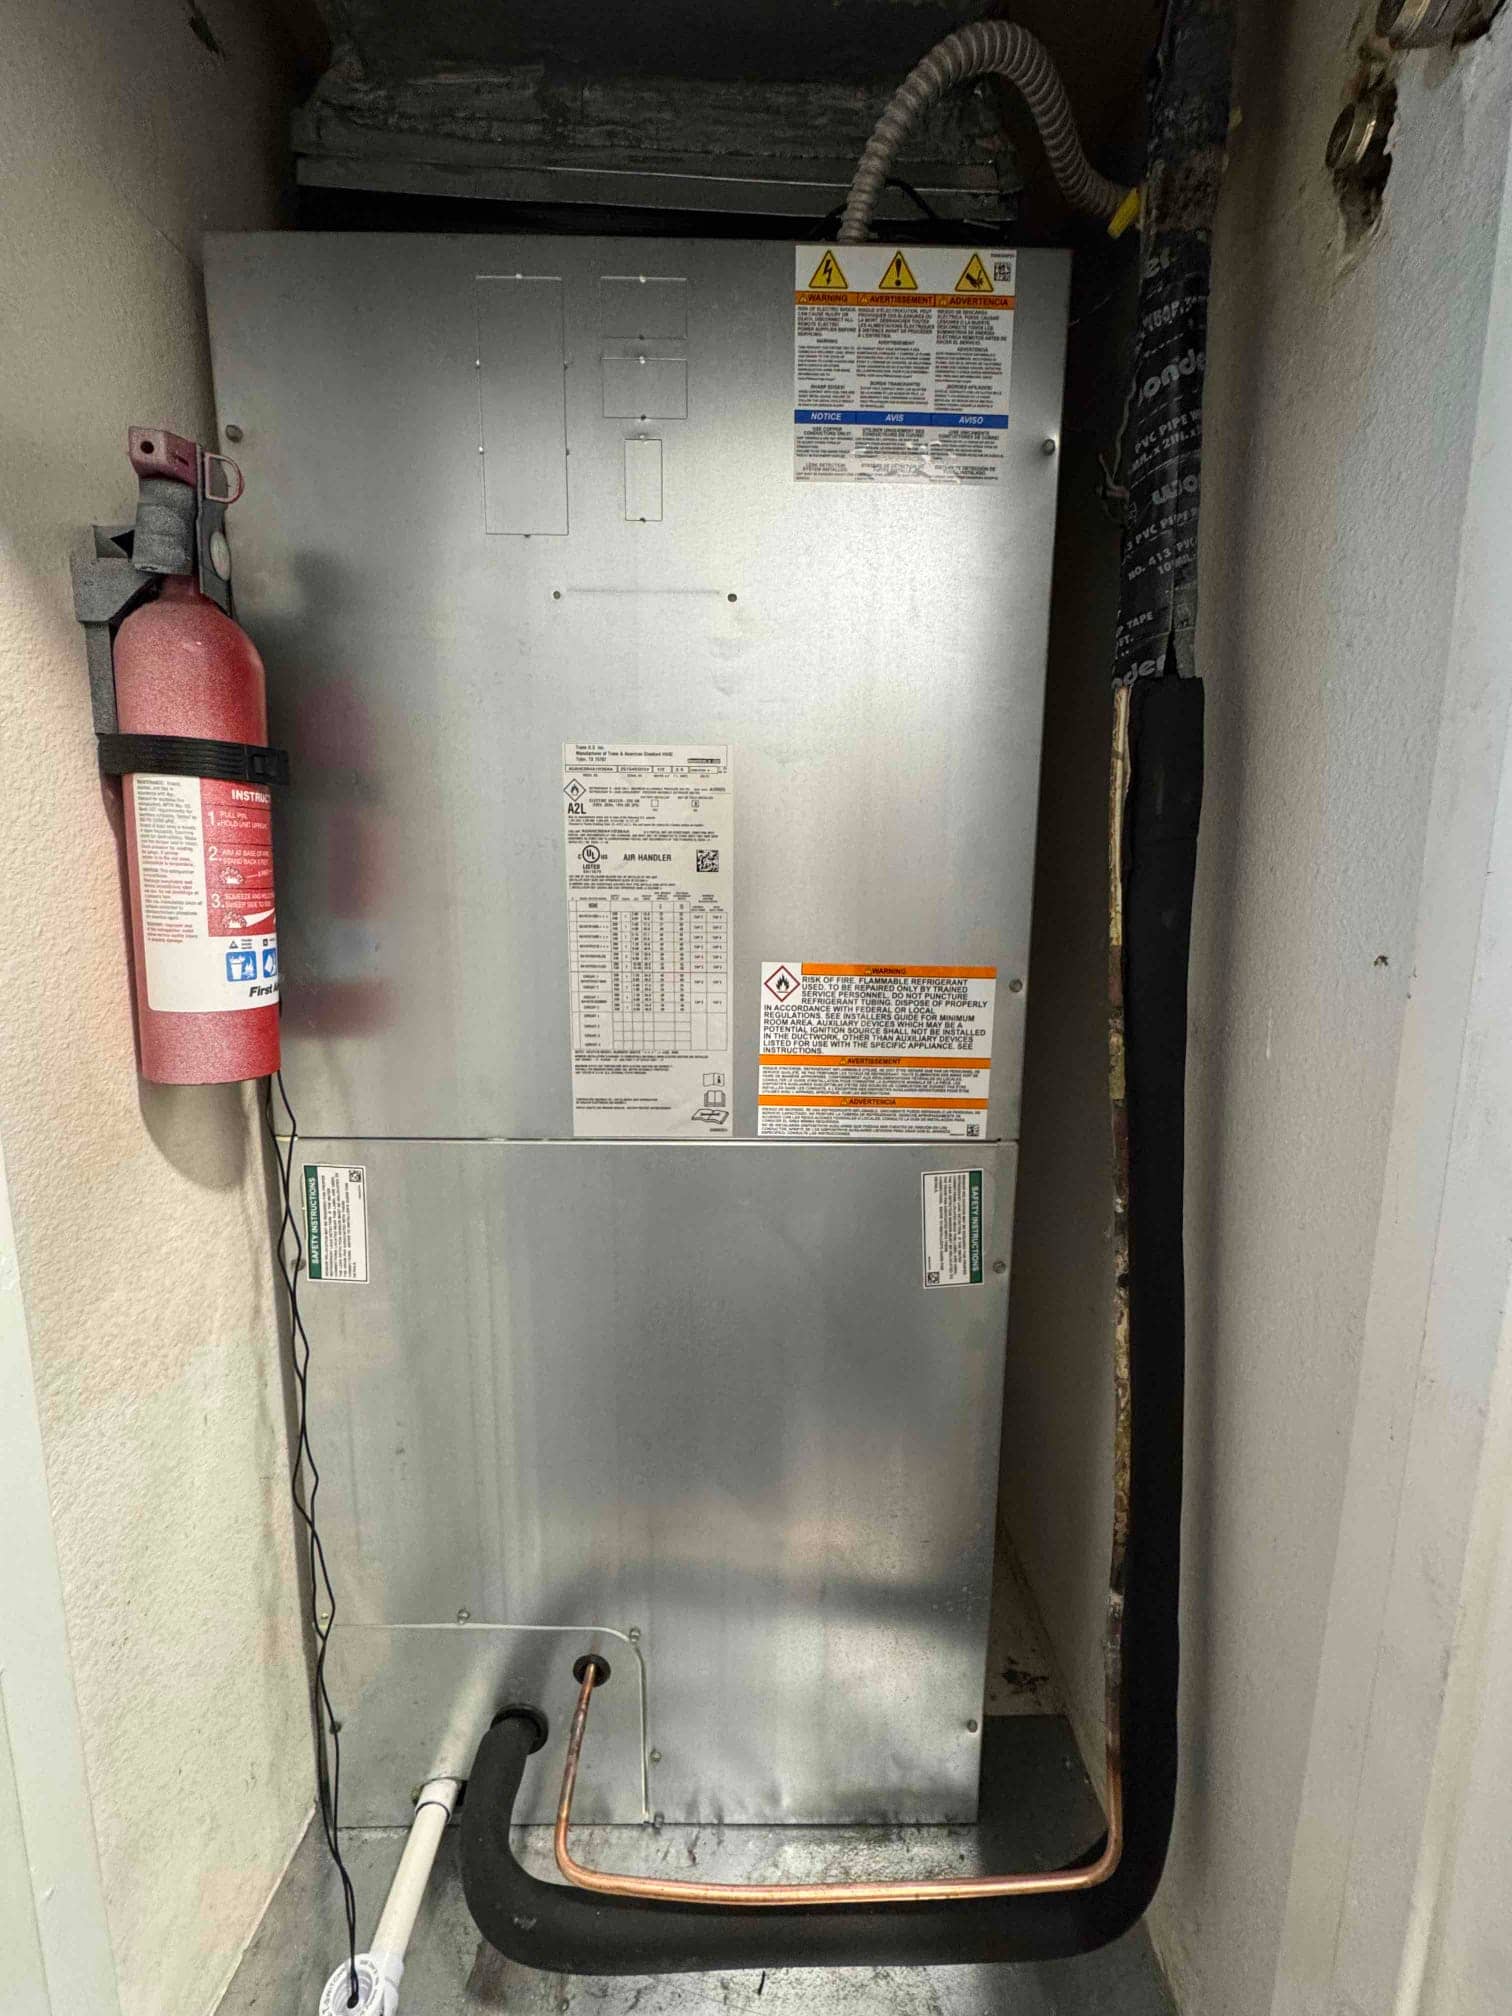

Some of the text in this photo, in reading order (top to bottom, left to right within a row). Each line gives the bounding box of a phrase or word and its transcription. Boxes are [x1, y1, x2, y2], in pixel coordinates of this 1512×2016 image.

[870, 296, 933, 305] AVERTISSEMENT
[950, 297, 1008, 306] ADVERTENCIA
[885, 414, 904, 422] AVIS
[959, 416, 983, 424] AVISO
[1136, 414, 1188, 454] PVC PIPE
[1136, 524, 1158, 544] PVC
[1128, 558, 1146, 580] NO.
[1126, 612, 1154, 629] TAPE
[568, 803, 587, 814] A2L
[208, 846, 222, 861] 2.
[586, 848, 596, 860] UL
[638, 854, 672, 862] HANDLER
[211, 893, 225, 908] 3.
[249, 984, 272, 997] First
[944, 1000, 988, 1008] PROPERLY
[308, 1177, 318, 1234] INSTRUCTIONS
